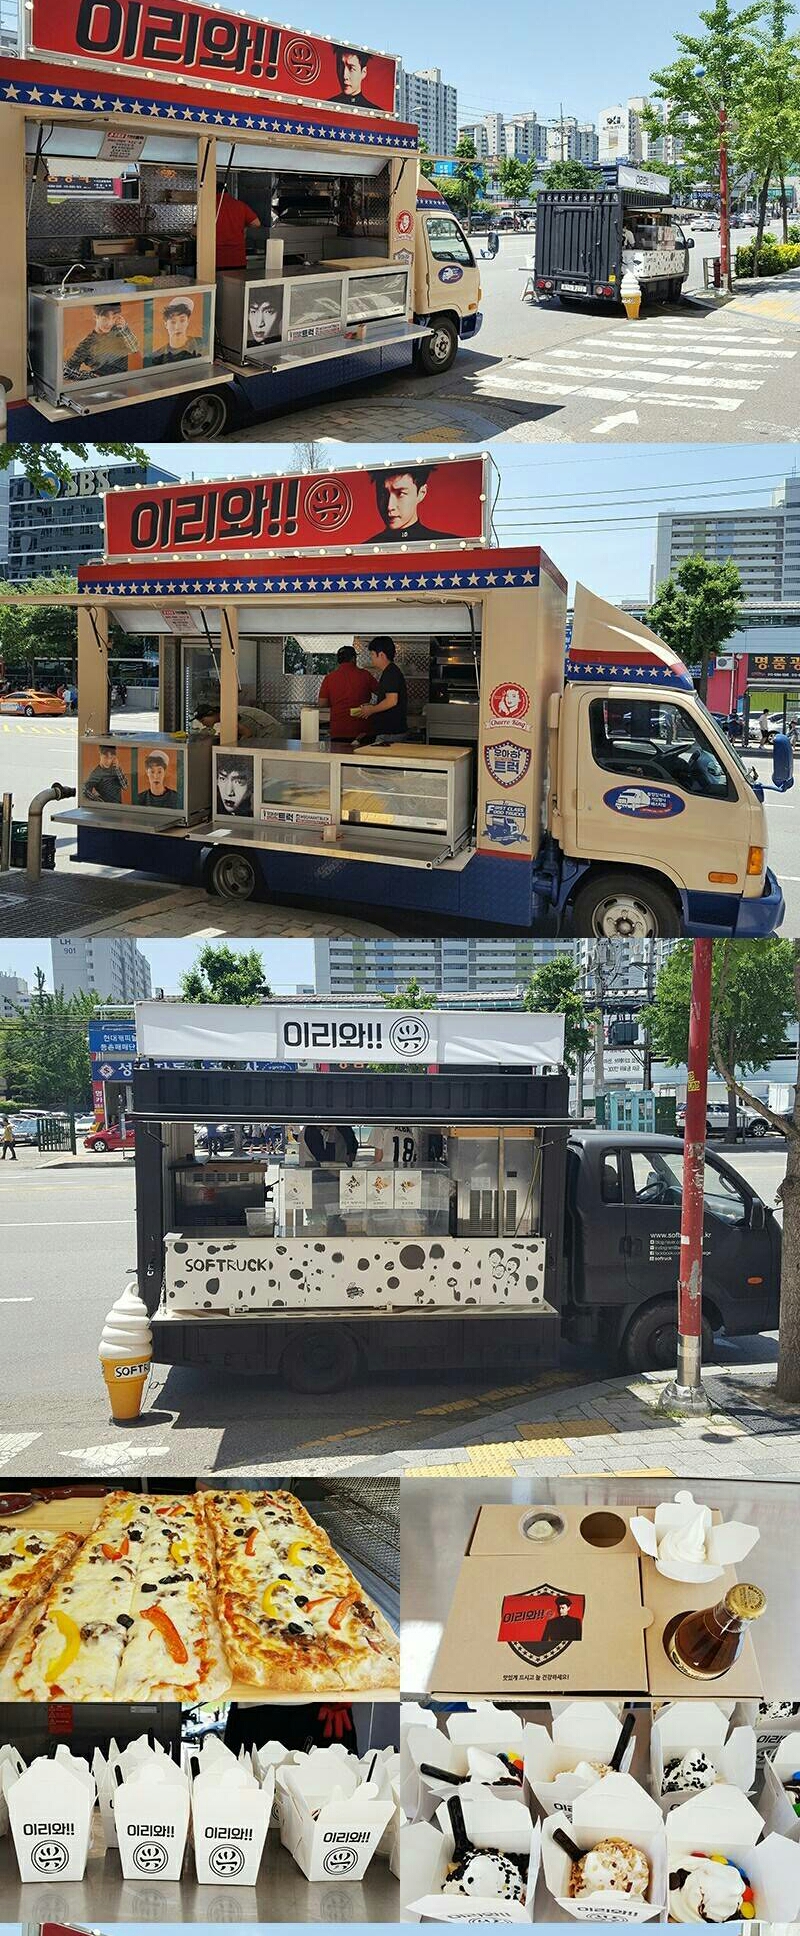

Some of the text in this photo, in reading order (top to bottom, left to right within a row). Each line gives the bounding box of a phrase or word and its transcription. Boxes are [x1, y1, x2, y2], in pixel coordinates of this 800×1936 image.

[76, 0, 281, 79] 이리와!!
[64, 469, 111, 497] SBS
[130, 479, 301, 550] 이리와!!
[494, 761, 519, 774] 트럭
[284, 1021, 383, 1049] 이리와!!
[392, 1135, 415, 1162] 18
[185, 1258, 268, 1273] SOFTRUCK
[23, 1822, 75, 1836] 이리와!!
[127, 1824, 175, 1838] 이리와!!
[204, 1826, 253, 1841] 이리와!!
[323, 1831, 371, 1843] 이리와!!
